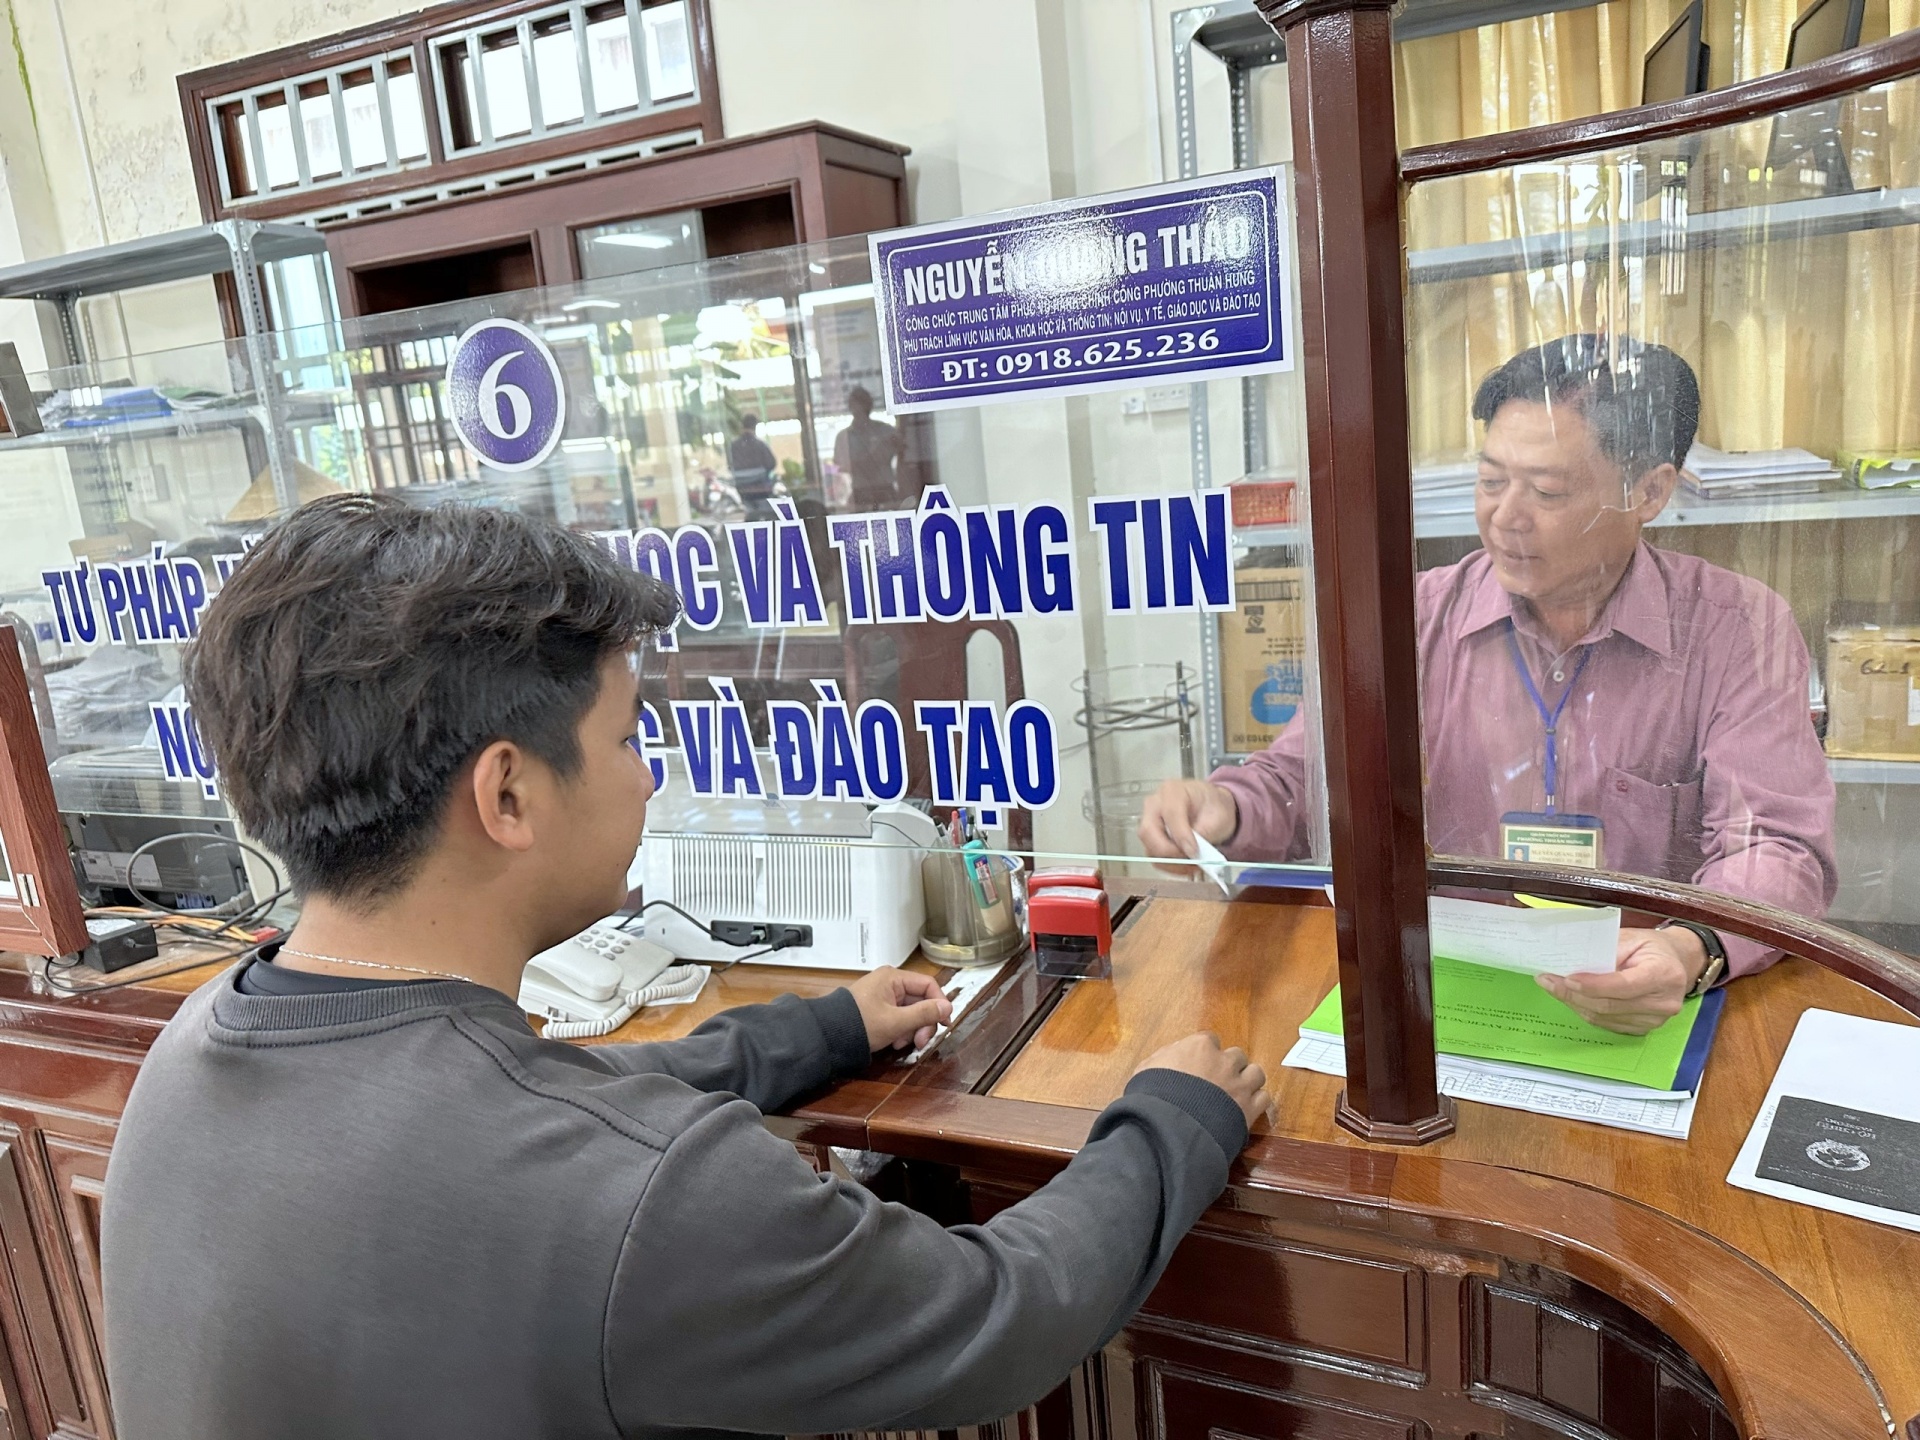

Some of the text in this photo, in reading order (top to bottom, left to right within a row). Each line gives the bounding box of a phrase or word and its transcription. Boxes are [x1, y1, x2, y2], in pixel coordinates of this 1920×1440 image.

[903, 338, 918, 354] PHỤ
[919, 333, 943, 351] TRÁCH
[944, 330, 961, 348] LĨNH
[962, 328, 978, 348] VỰC
[979, 326, 995, 343] VĂN
[1015, 323, 1036, 339] KHOA
[1037, 320, 1054, 338] HỌC
[1055, 316, 1067, 333] VÀ
[1067, 312, 1096, 331] THÔNG
[1114, 309, 1128, 328] NỘI
[1129, 308, 1144, 325] VỤ,
[1144, 306, 1152, 321] Y
[1152, 299, 1166, 321] TẾ,
[1167, 298, 1188, 319] GIÁO
[1189, 299, 1208, 318] DỤC
[1209, 293, 1221, 313] VÀ
[1223, 291, 1241, 311] ĐÀO
[1242, 291, 1261, 311] TẠO
[905, 314, 930, 332] CÔNG
[931, 309, 956, 328] CHỨC
[957, 307, 988, 325] TRUNG
[989, 303, 1009, 320] TÂM
[1113, 284, 1141, 304] CÔNG
[1143, 278, 1186, 299] PHƯỜNG
[1187, 271, 1223, 293] THUẬN
[477, 349, 533, 441] 6
[941, 328, 1220, 382] ĐT: 0918.625.236
[43, 560, 98, 644] TƯ
[98, 544, 206, 643] PHÁP
[602, 489, 1232, 650] ỌC VÀ THÔNG TIN
[679, 683, 764, 797] VÀ
[772, 682, 905, 803] ĐÀO
[919, 702, 1058, 829] TẠO
